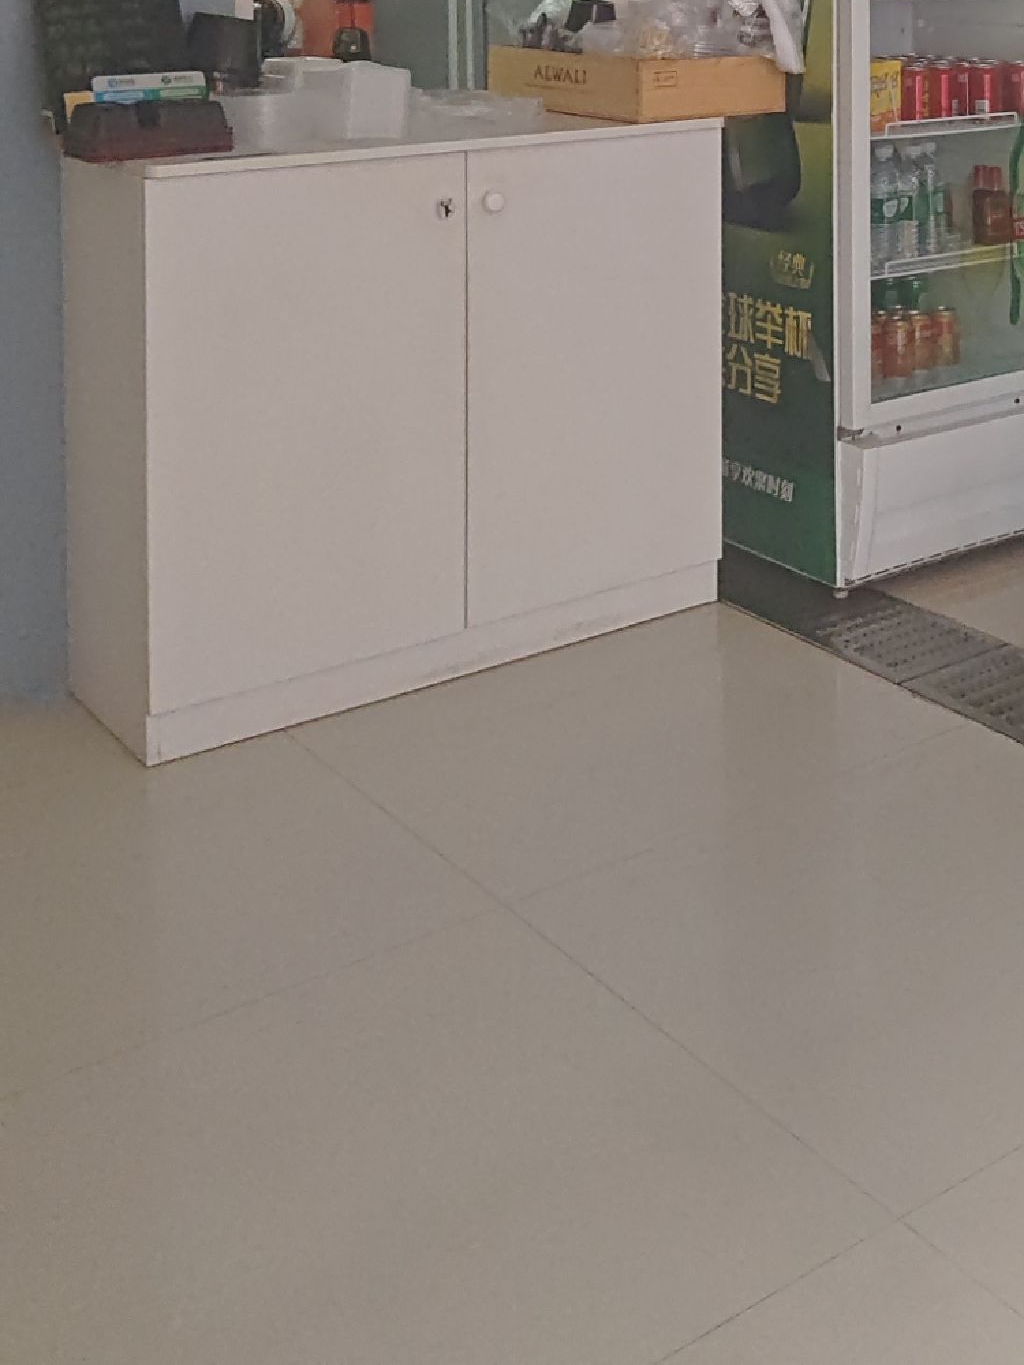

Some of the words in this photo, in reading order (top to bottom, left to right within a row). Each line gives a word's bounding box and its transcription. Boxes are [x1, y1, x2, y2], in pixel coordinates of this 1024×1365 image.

[724, 292, 812, 360] 球举杯
[724, 343, 781, 404] 分享
